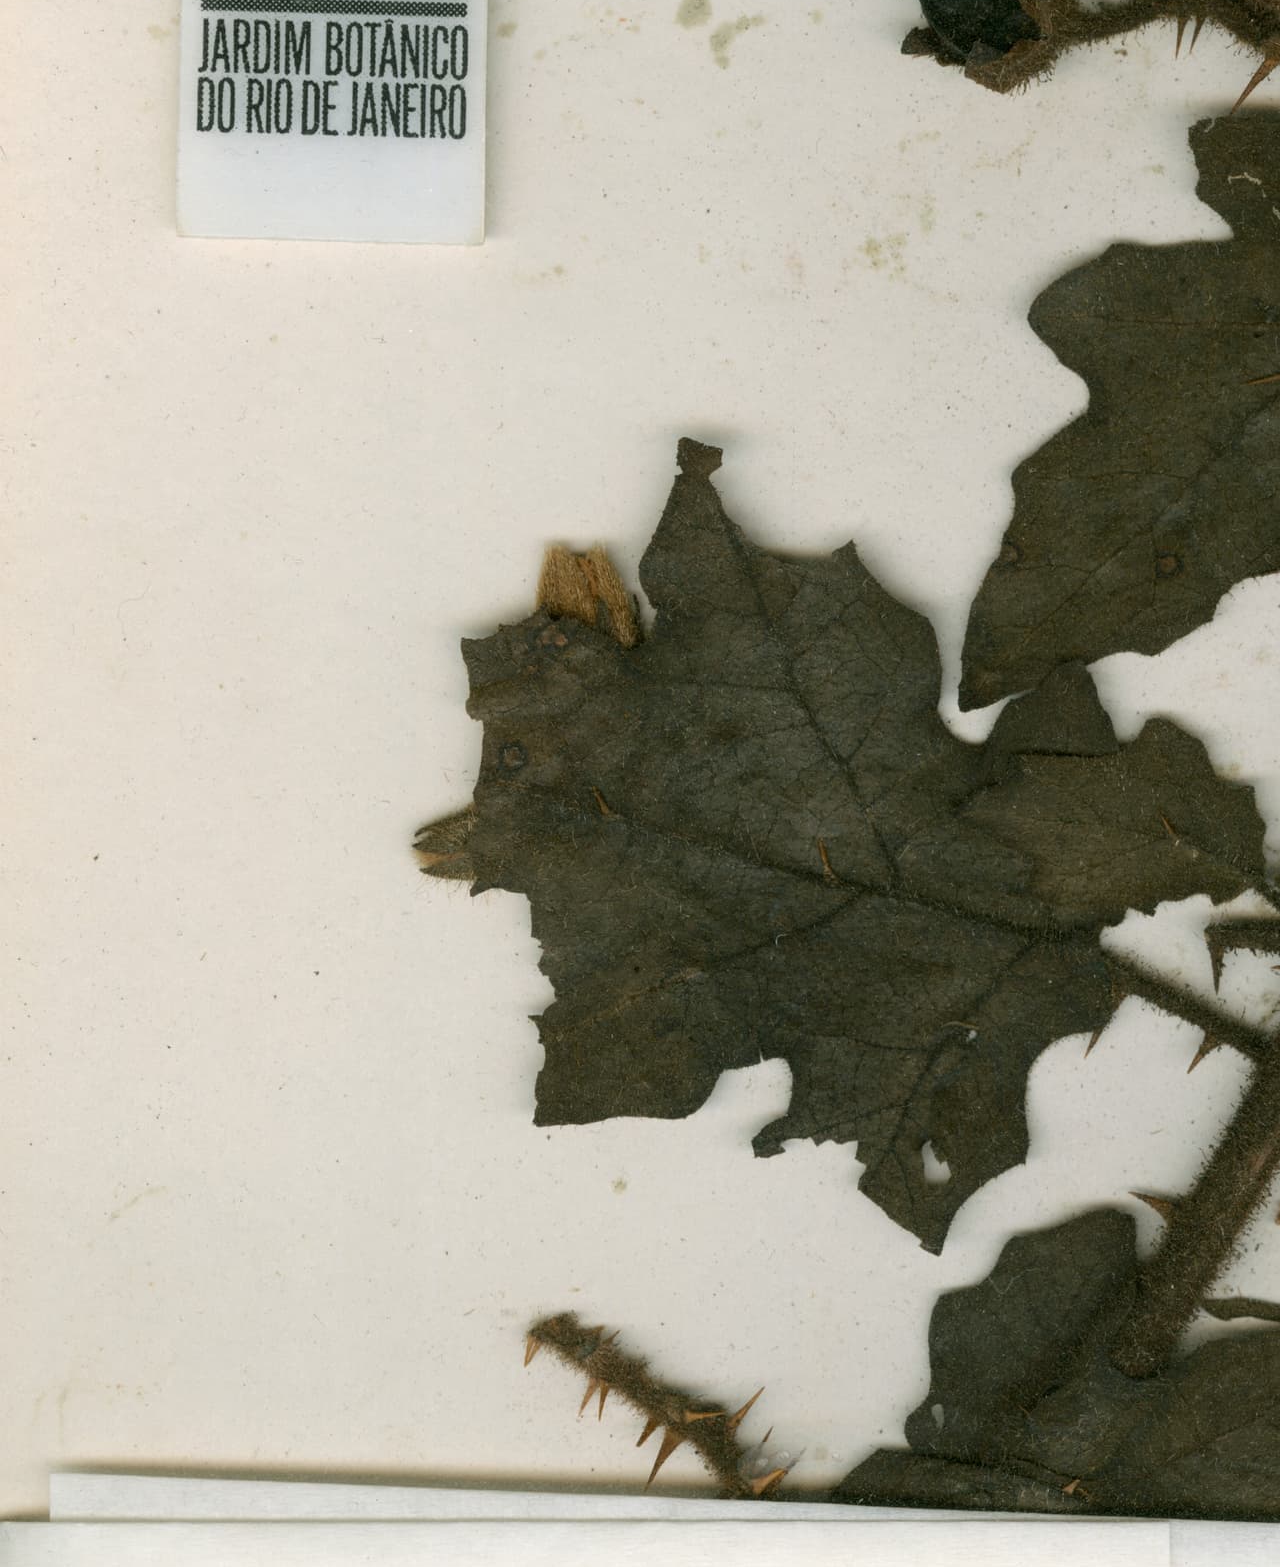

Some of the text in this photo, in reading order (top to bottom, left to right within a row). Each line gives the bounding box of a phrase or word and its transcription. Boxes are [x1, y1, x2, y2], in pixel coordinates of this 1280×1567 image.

[198, 18, 468, 80] JARDIM BOTÂNICO
[197, 77, 467, 139] DO RIO DE JANEIRO
